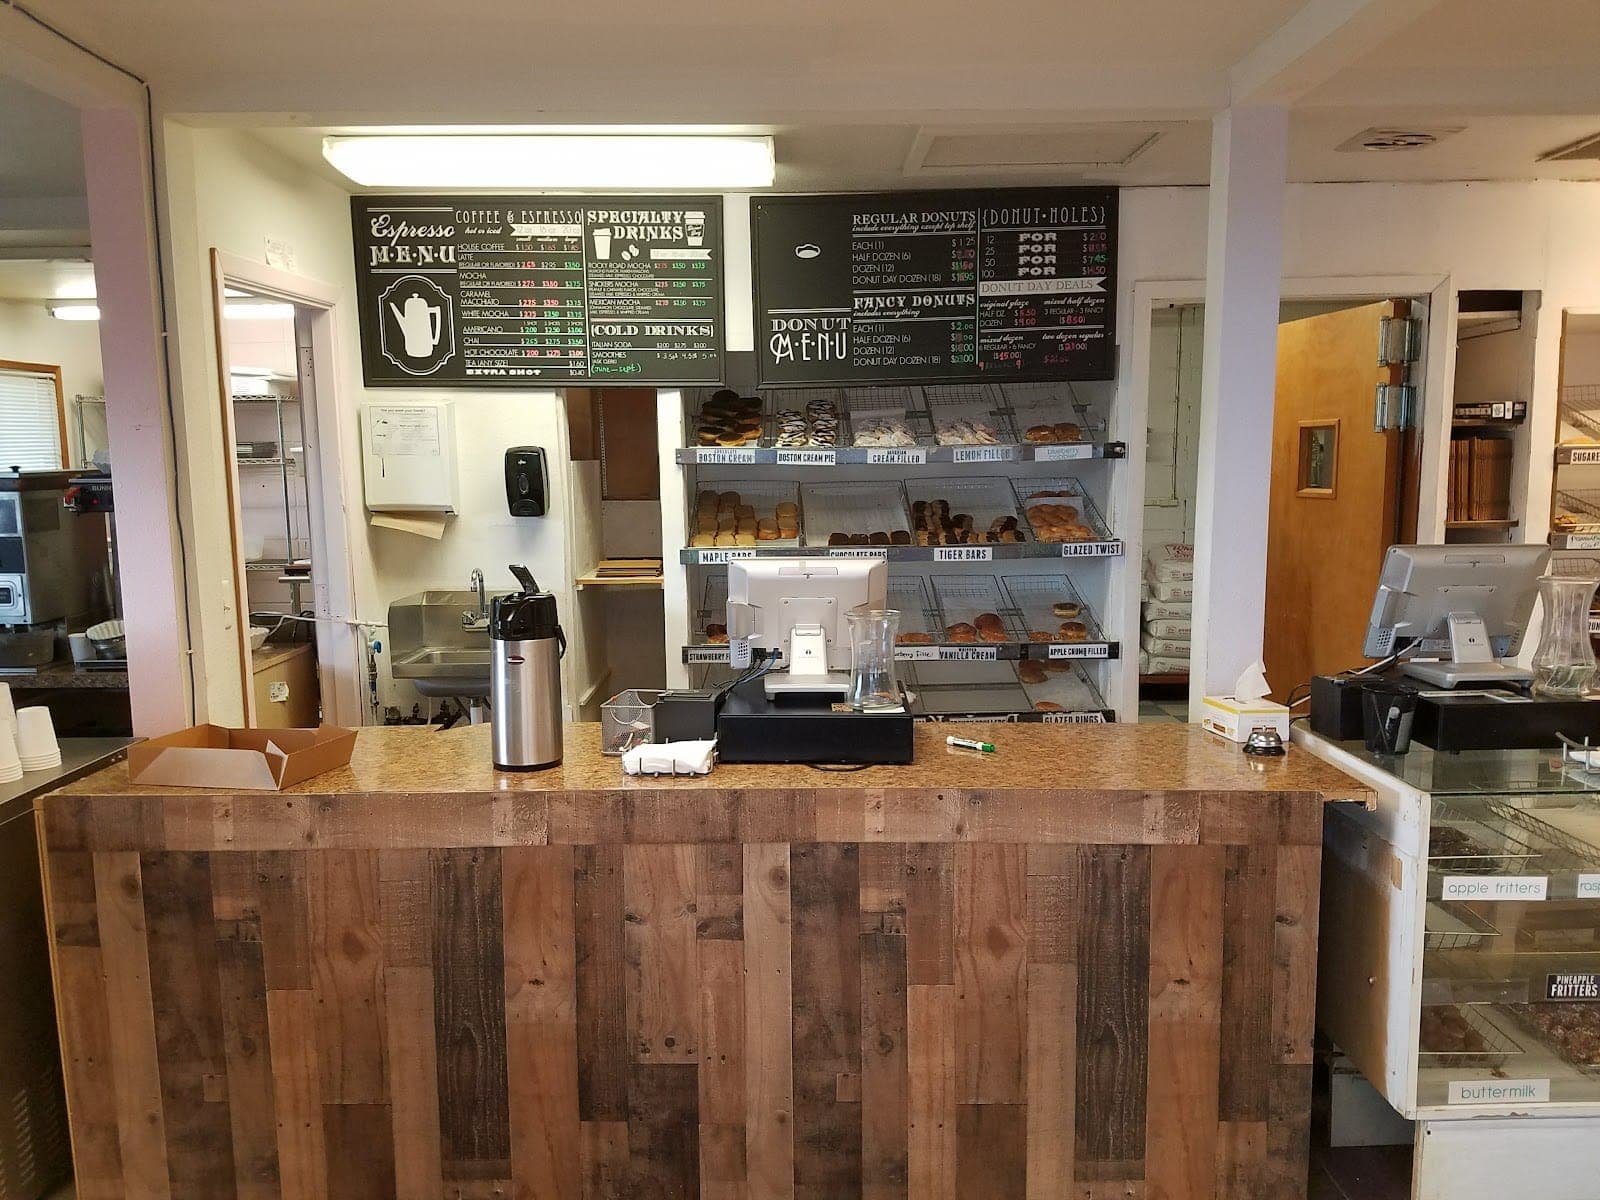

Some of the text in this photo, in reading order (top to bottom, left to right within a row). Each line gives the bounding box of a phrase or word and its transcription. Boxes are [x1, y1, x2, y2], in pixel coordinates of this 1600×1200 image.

[455, 210, 582, 224] COFFEE & ESPRESSO
[587, 210, 684, 226] SPECIALTY
[852, 211, 976, 225] REGULAR DONUTS
[370, 214, 456, 247] Espresso
[613, 225, 684, 242] DRINKS
[880, 223, 920, 234] everything
[986, 232, 1057, 244] 12 FOR
[852, 241, 873, 250] EACH
[985, 247, 995, 256] 25
[1018, 244, 1057, 254] FOR
[852, 252, 911, 262] HALF DOZEN (6)
[984, 255, 1057, 267] 50 FOR
[852, 264, 880, 273] DOZEN
[981, 266, 1056, 278] 100 FOR
[852, 275, 880, 284] DONUT
[882, 275, 897, 284] DAY
[899, 274, 927, 283] DOZEN
[982, 279, 1093, 293] DONUT DAY DEALS
[853, 293, 976, 309] FANCY DONUTS
[980, 299, 1010, 310] original
[1084, 296, 1105, 306] dozen
[882, 308, 920, 318] everything
[980, 310, 995, 318] HALF
[770, 317, 851, 331] DONUT
[853, 324, 874, 333] EACH
[980, 319, 1003, 327] DOZEN
[853, 334, 911, 344] HALF DOZEN (6)
[1003, 333, 1024, 344] dozen
[1055, 331, 1077, 342] dozen
[853, 346, 880, 355] DOZEN
[853, 357, 881, 366] DONUT
[882, 356, 898, 365] DAY
[899, 356, 927, 365] DOZEN
[698, 453, 752, 463] BOSTON CREAM
[778, 452, 835, 463] BOSTON CREAM PIE
[872, 454, 920, 463] CREAM FILLED
[956, 450, 982, 461] LEMON
[939, 549, 987, 560] TIGER BARS
[1064, 543, 1120, 556] GLAZED TWIST
[703, 551, 728, 563] MAPLE
[689, 653, 725, 661] STRAWBERRY
[940, 651, 995, 660] VANILLA CREAM
[1050, 647, 1067, 656] APPLE
[1448, 881, 1541, 895] apple fritters
[1551, 974, 1598, 997] PINEAPPLE FRITTERS
[1461, 1084, 1537, 1099] buttermilk
